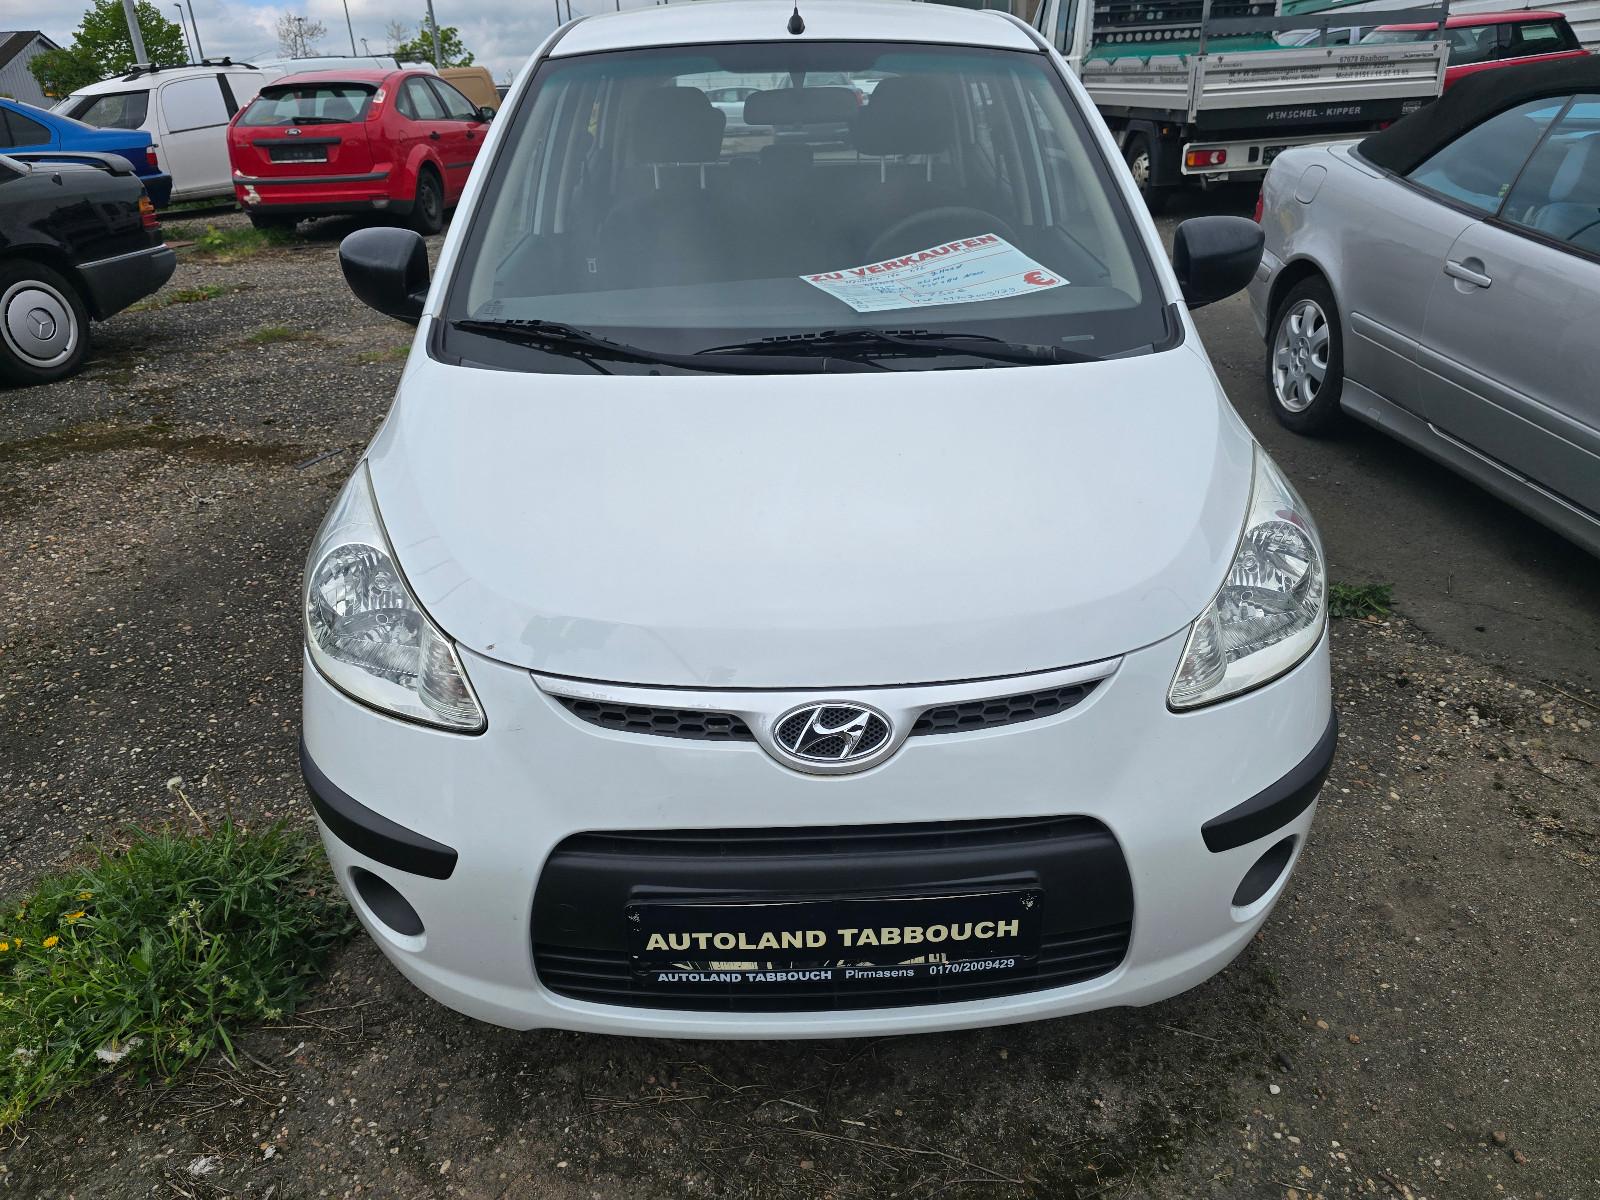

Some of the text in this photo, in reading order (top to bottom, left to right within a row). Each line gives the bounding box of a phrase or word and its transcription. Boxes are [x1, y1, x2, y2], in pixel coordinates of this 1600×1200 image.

[1326, 106, 1361, 116] KIPPER
[806, 272, 844, 282] ZU
[847, 235, 999, 277] VERKAUFEN
[646, 919, 1019, 951] AUTOLAND TABBOUCH
[657, 958, 1015, 983] AUTOLAND TABBOUCH Pirmasens 0170/2009429
